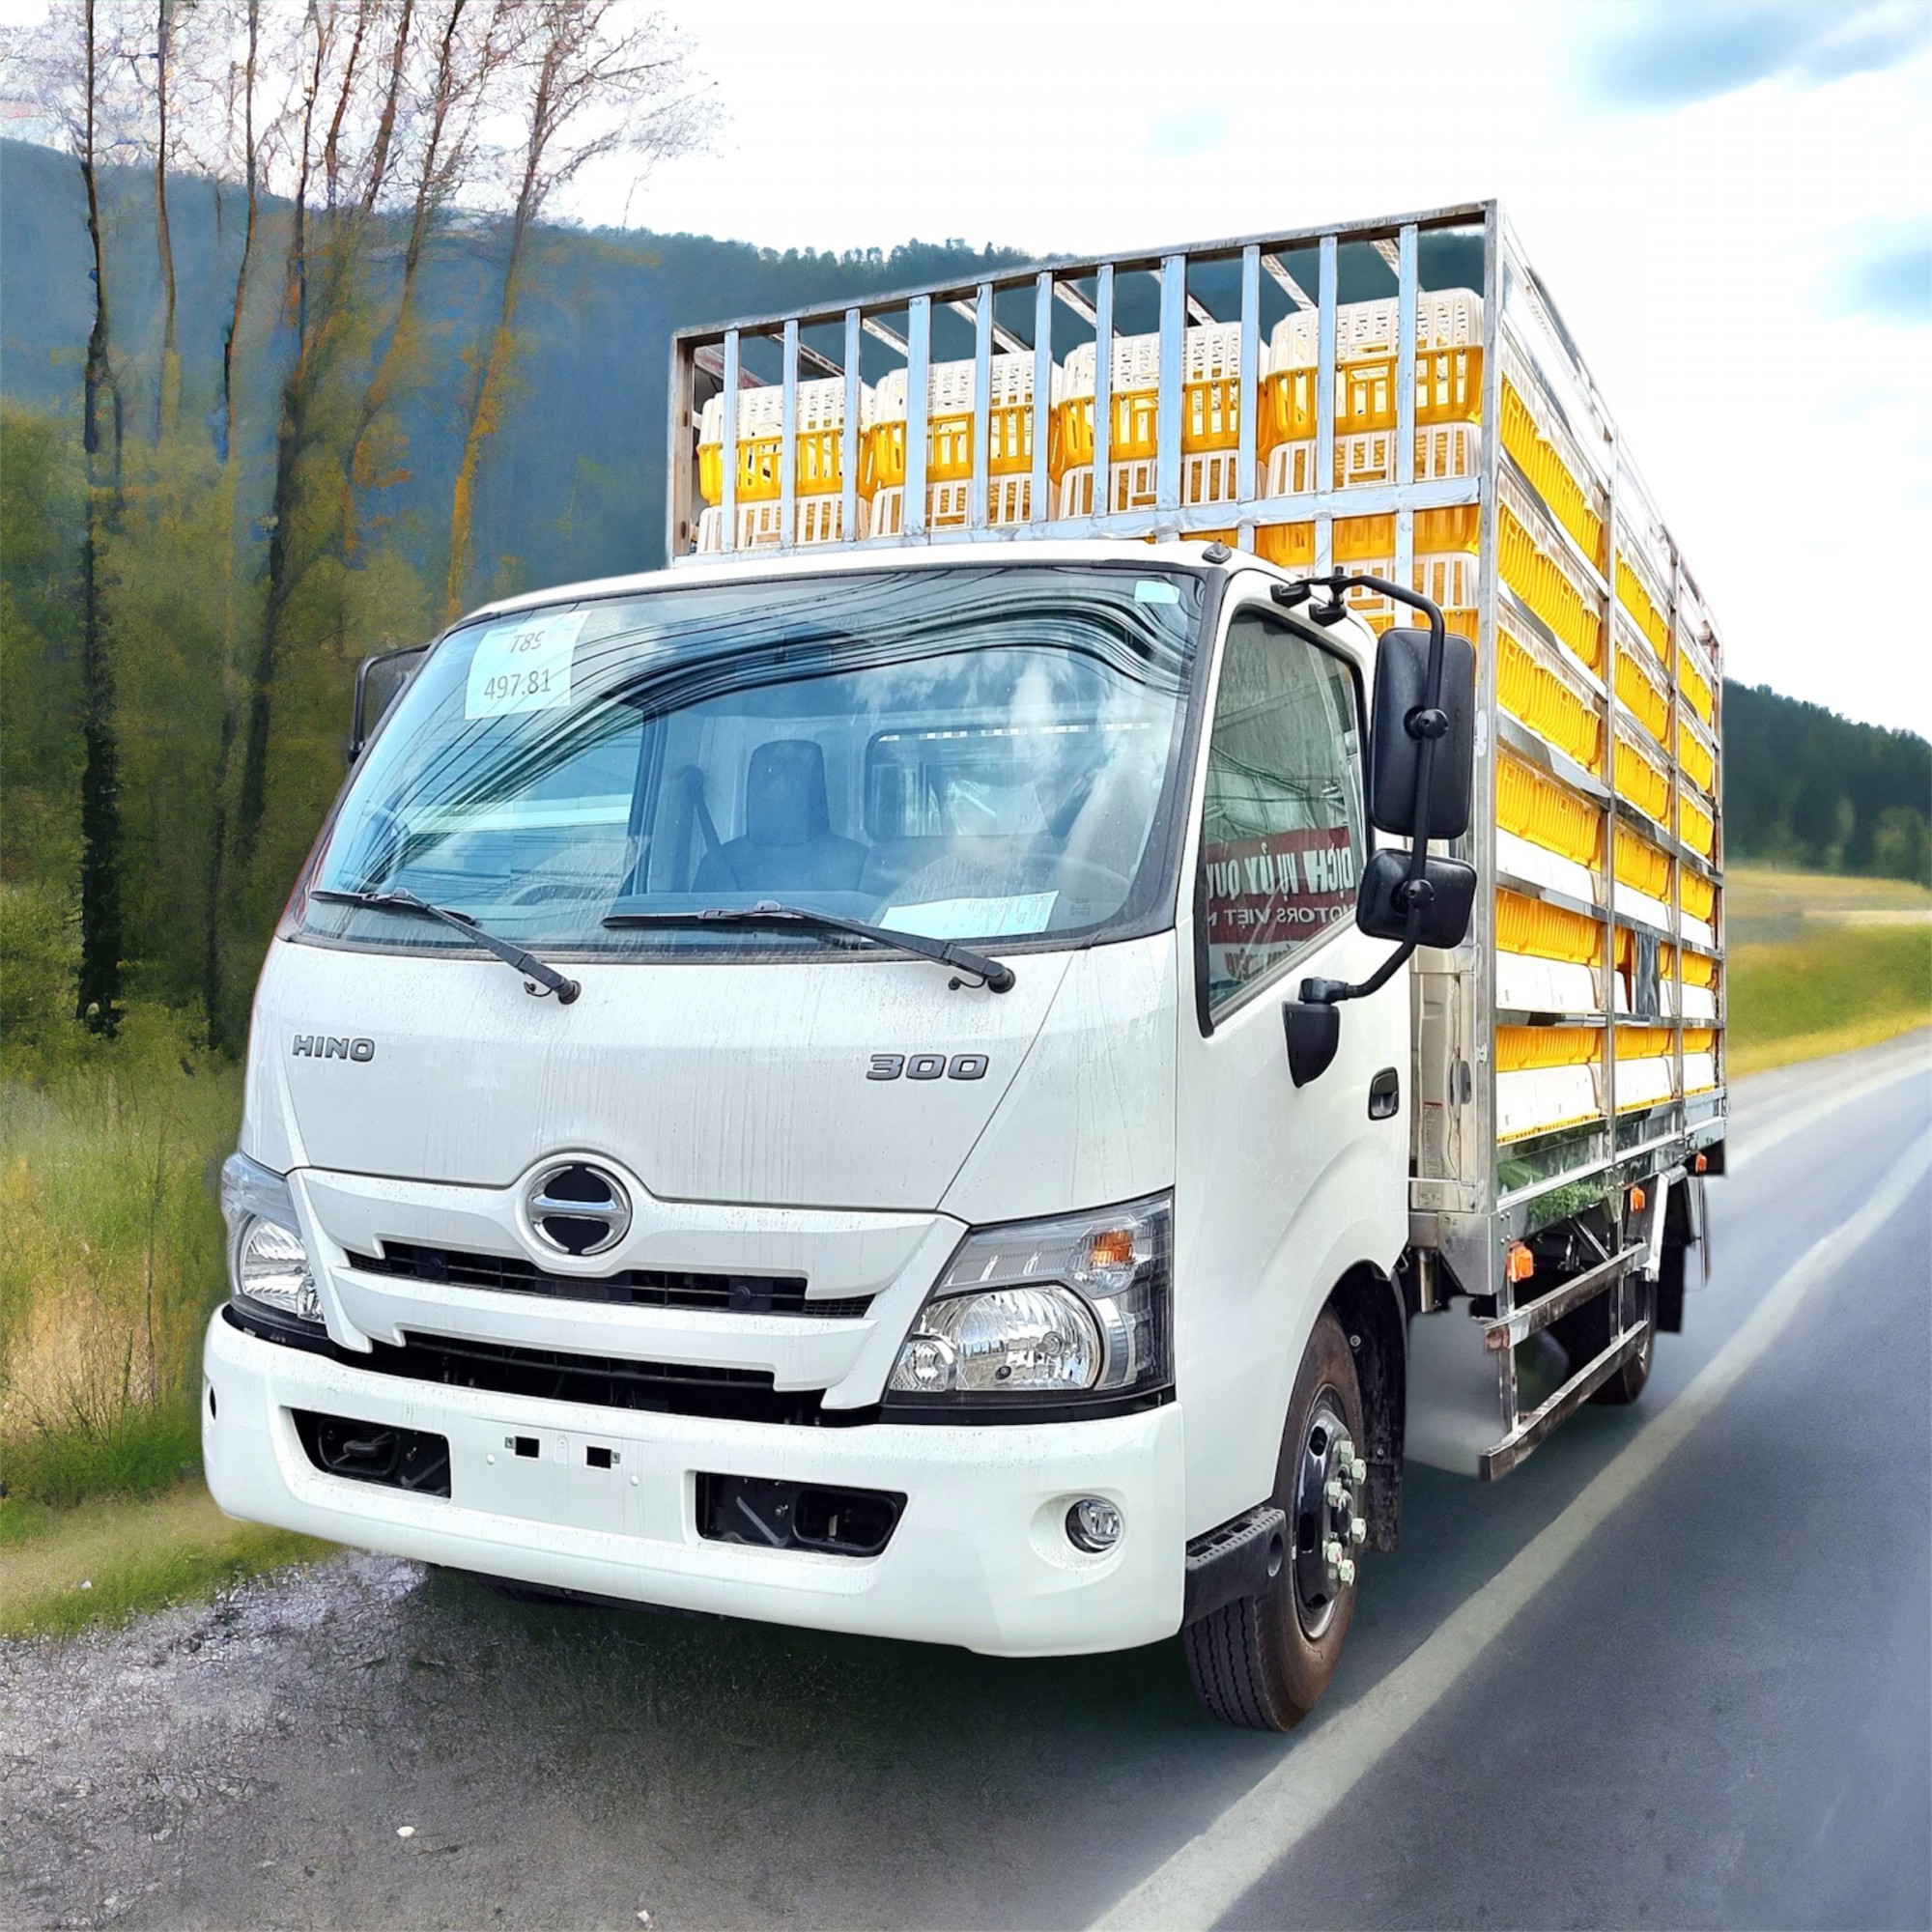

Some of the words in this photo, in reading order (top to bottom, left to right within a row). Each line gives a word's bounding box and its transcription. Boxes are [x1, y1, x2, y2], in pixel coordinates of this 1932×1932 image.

[484, 669, 552, 700] 497.81
[293, 1035, 375, 1062] HINO
[866, 1054, 989, 1080] 300
